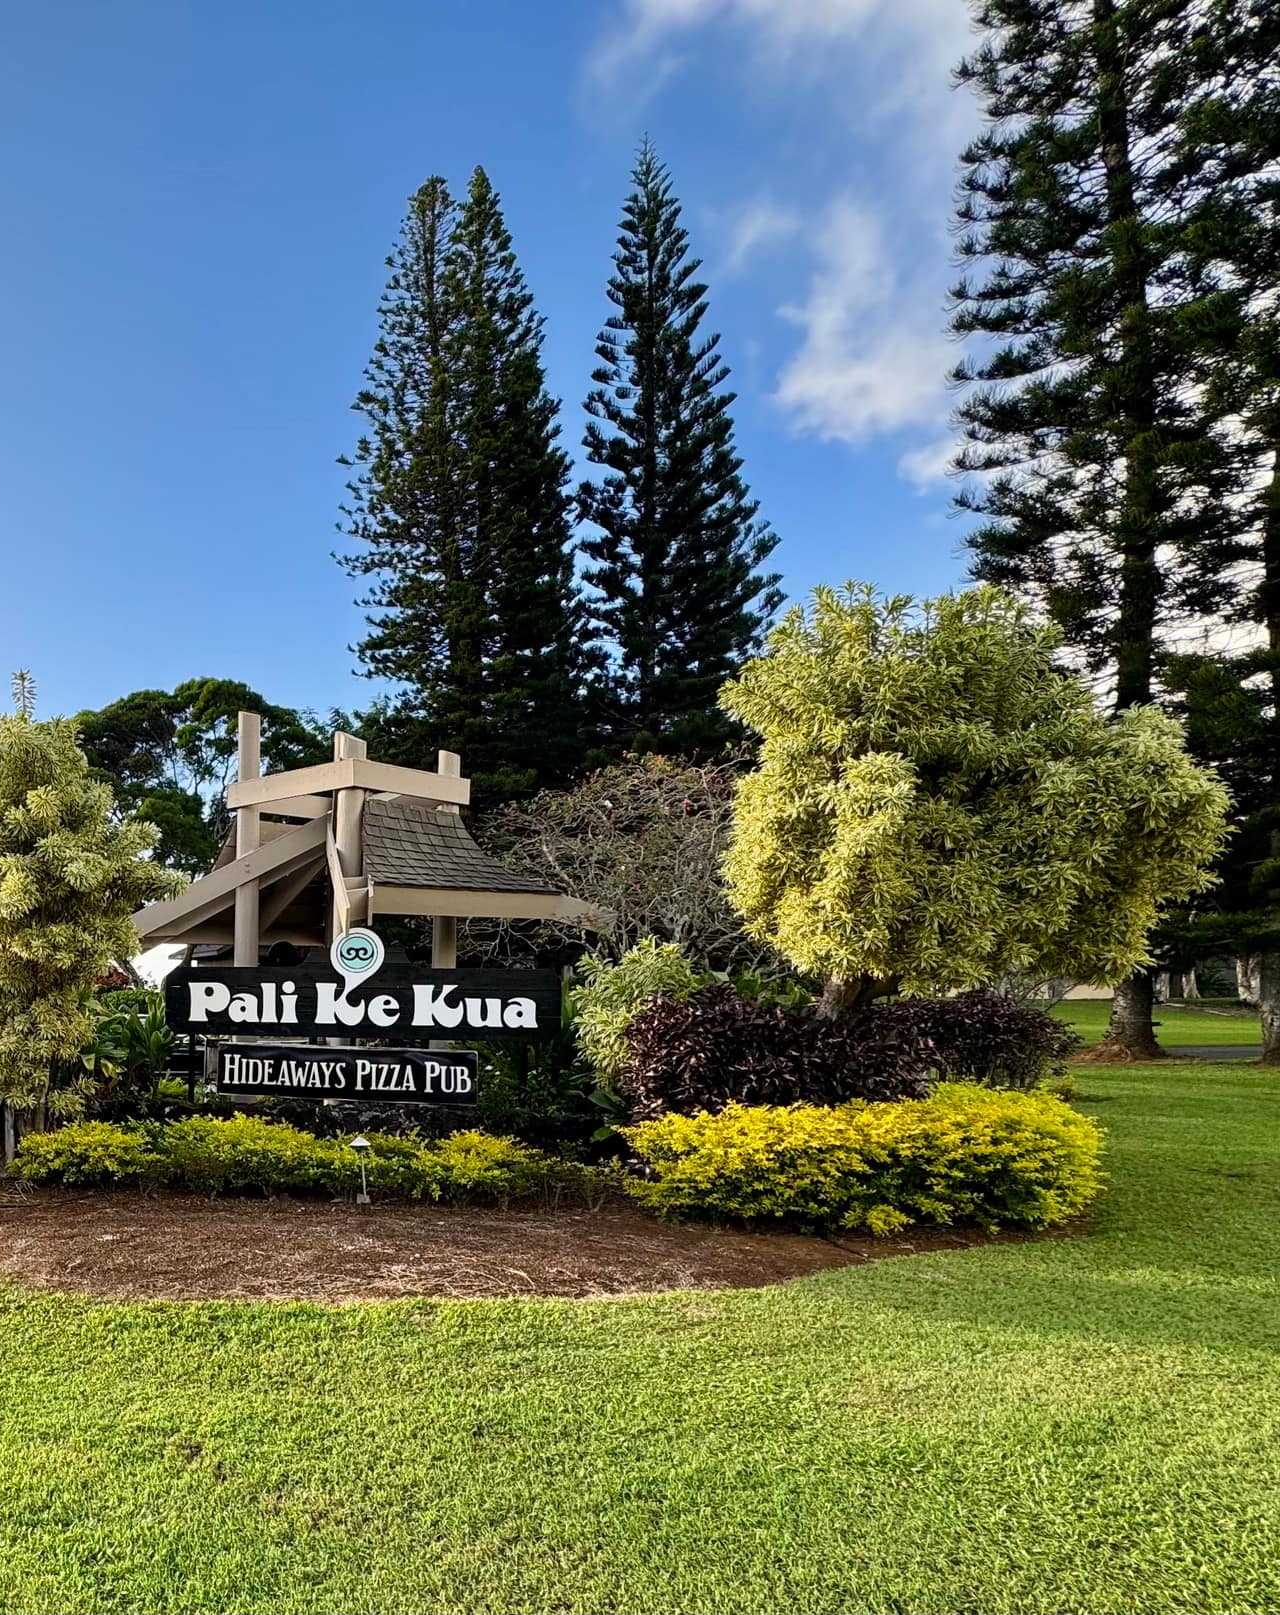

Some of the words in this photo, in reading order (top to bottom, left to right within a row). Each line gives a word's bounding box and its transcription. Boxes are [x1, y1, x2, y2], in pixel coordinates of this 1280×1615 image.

[188, 981, 299, 1024] Pali
[315, 981, 401, 1027] Ke
[411, 984, 539, 1029] Kua
[223, 1053, 346, 1089] HIDEAWAYS
[354, 1059, 417, 1091] PIZZA
[424, 1061, 472, 1094] PUB
